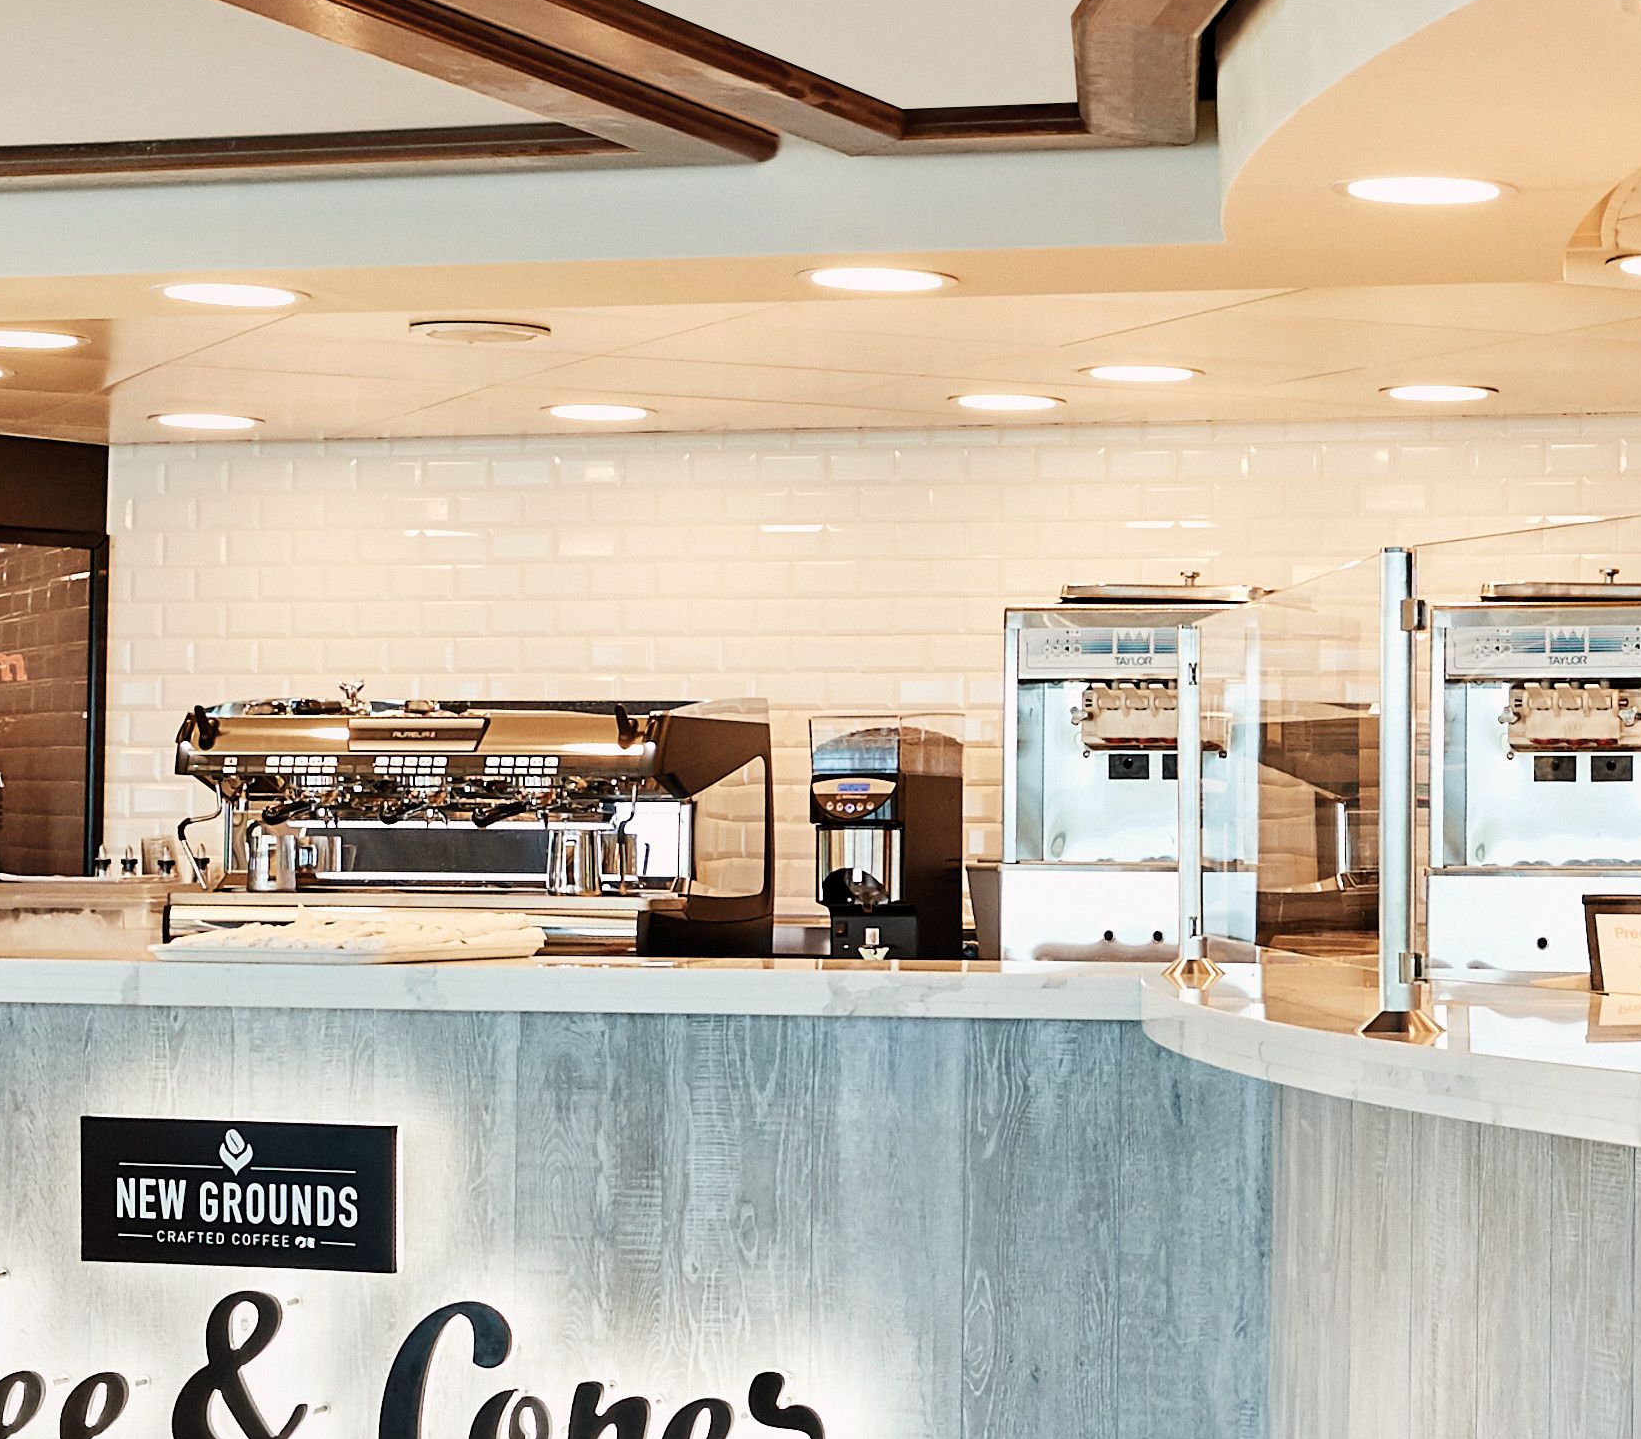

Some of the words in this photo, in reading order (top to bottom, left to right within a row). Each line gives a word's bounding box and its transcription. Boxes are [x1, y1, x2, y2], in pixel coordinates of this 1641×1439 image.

[1114, 656, 1153, 666] TAYLOR
[1548, 655, 1588, 665] TAYLOR
[115, 1176, 187, 1220] NEW
[198, 1180, 359, 1229] GROUNDS
[156, 1229, 226, 1246] CRAFTED
[231, 1231, 291, 1248] COFFEE
